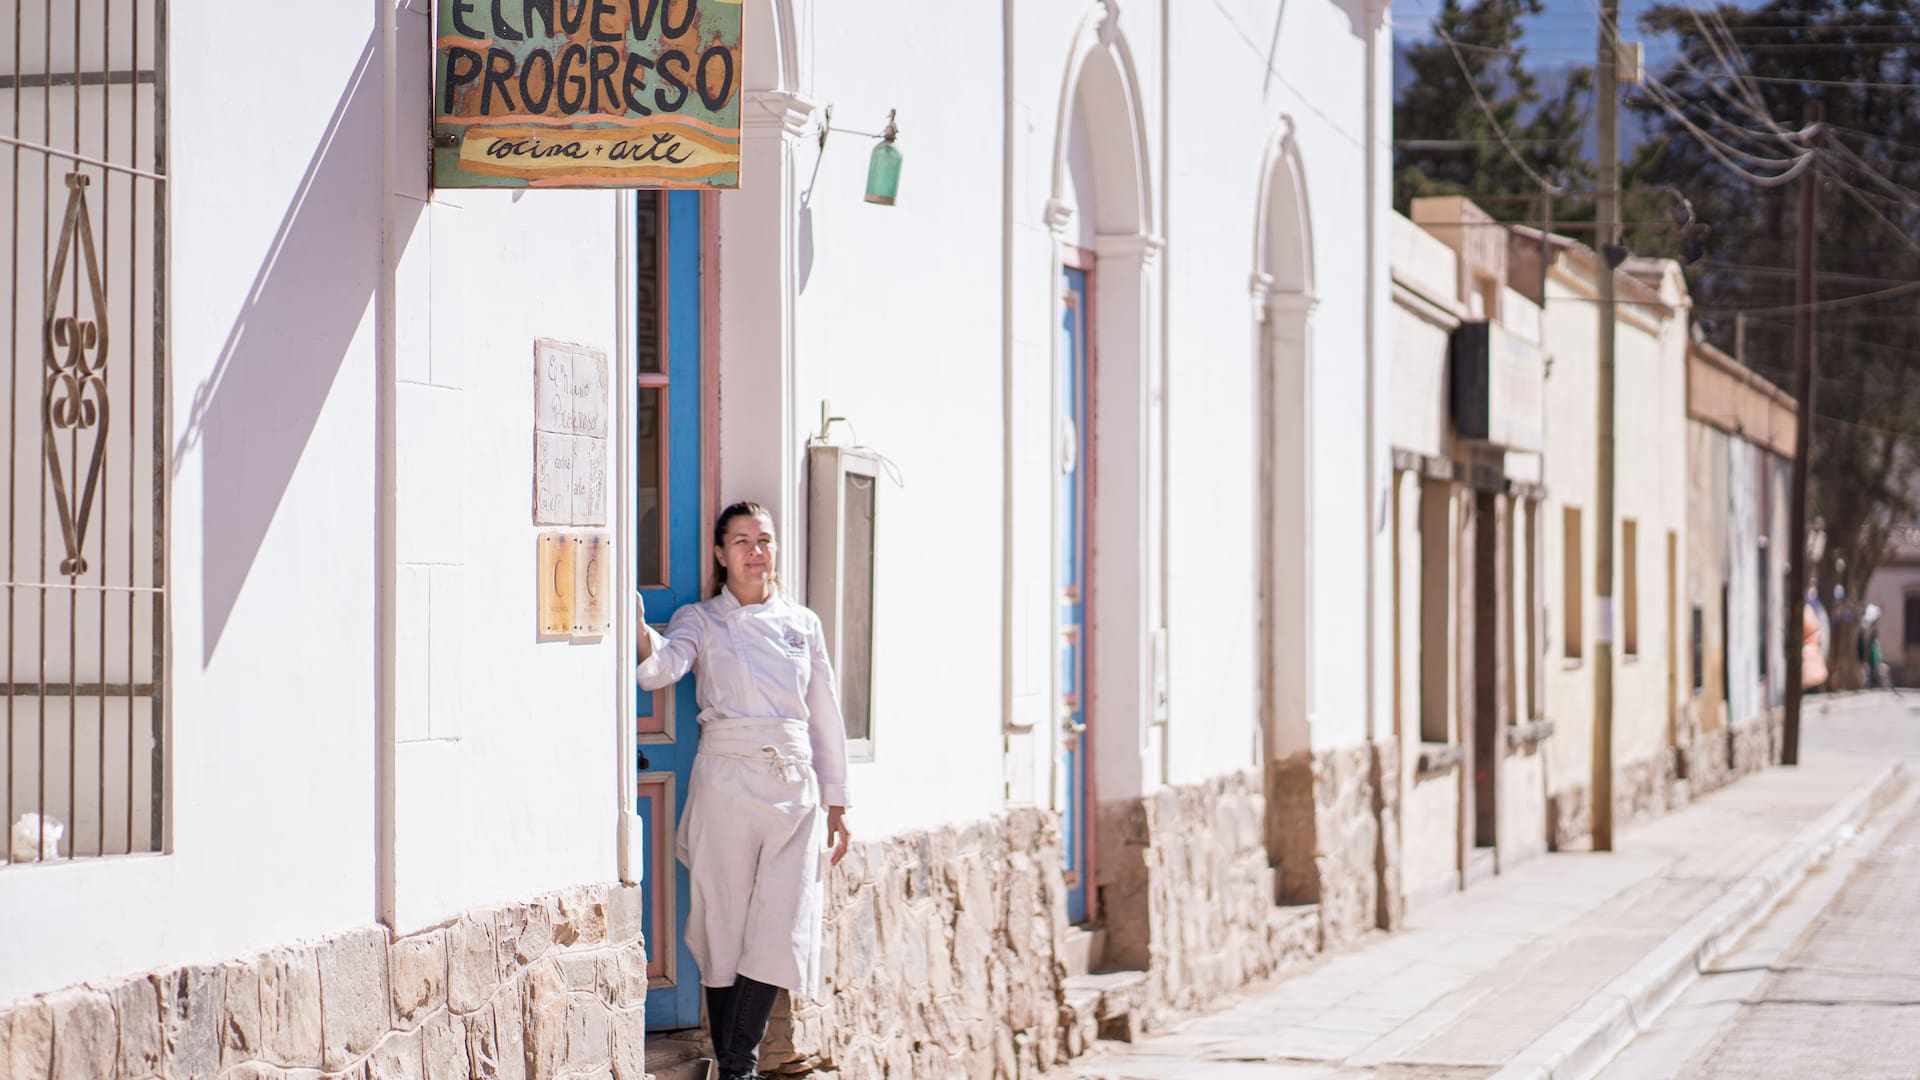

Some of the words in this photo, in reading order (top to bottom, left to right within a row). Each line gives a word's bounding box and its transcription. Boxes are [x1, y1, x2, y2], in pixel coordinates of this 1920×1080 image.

[444, 45, 733, 115] PROGRESO
[486, 138, 590, 160] cocina
[608, 132, 696, 164] arte
